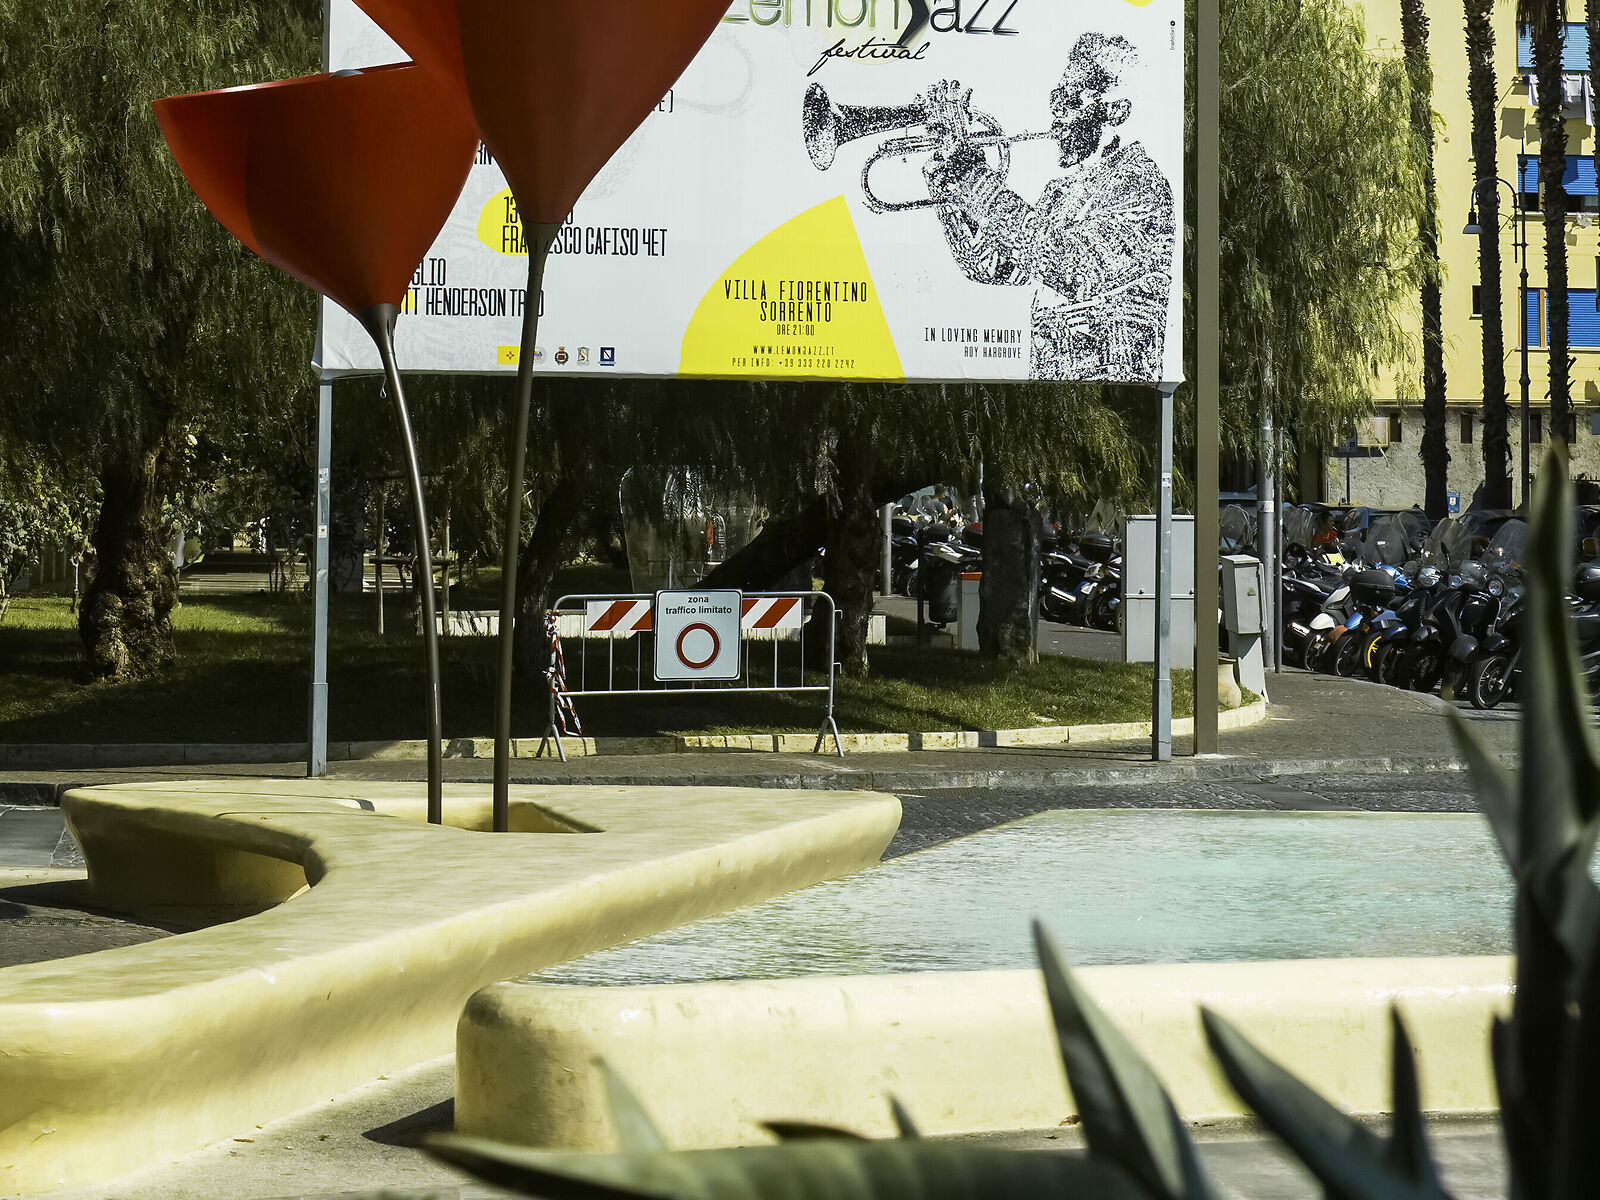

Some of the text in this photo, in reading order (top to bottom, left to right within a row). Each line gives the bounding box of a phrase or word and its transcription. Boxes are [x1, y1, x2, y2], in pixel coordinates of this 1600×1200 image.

[807, 37, 930, 77] festival
[586, 227, 638, 256] CAFISO
[724, 279, 867, 302] VILLA FIORENTINO
[425, 288, 506, 316] HENDERSON
[760, 301, 832, 322] SORRENTO
[776, 324, 815, 336] ORE 21:00
[924, 327, 1022, 344] IN LOVING MEMORY
[753, 345, 835, 356] WWW.LEMONJAZZ.IT
[964, 346, 1021, 358] ROY HARGROVE
[732, 357, 747, 367] PER
[750, 357, 774, 367] INFO:
[797, 358, 813, 368] 333
[687, 596, 709, 604] zona
[665, 605, 733, 614] traffico limitato
